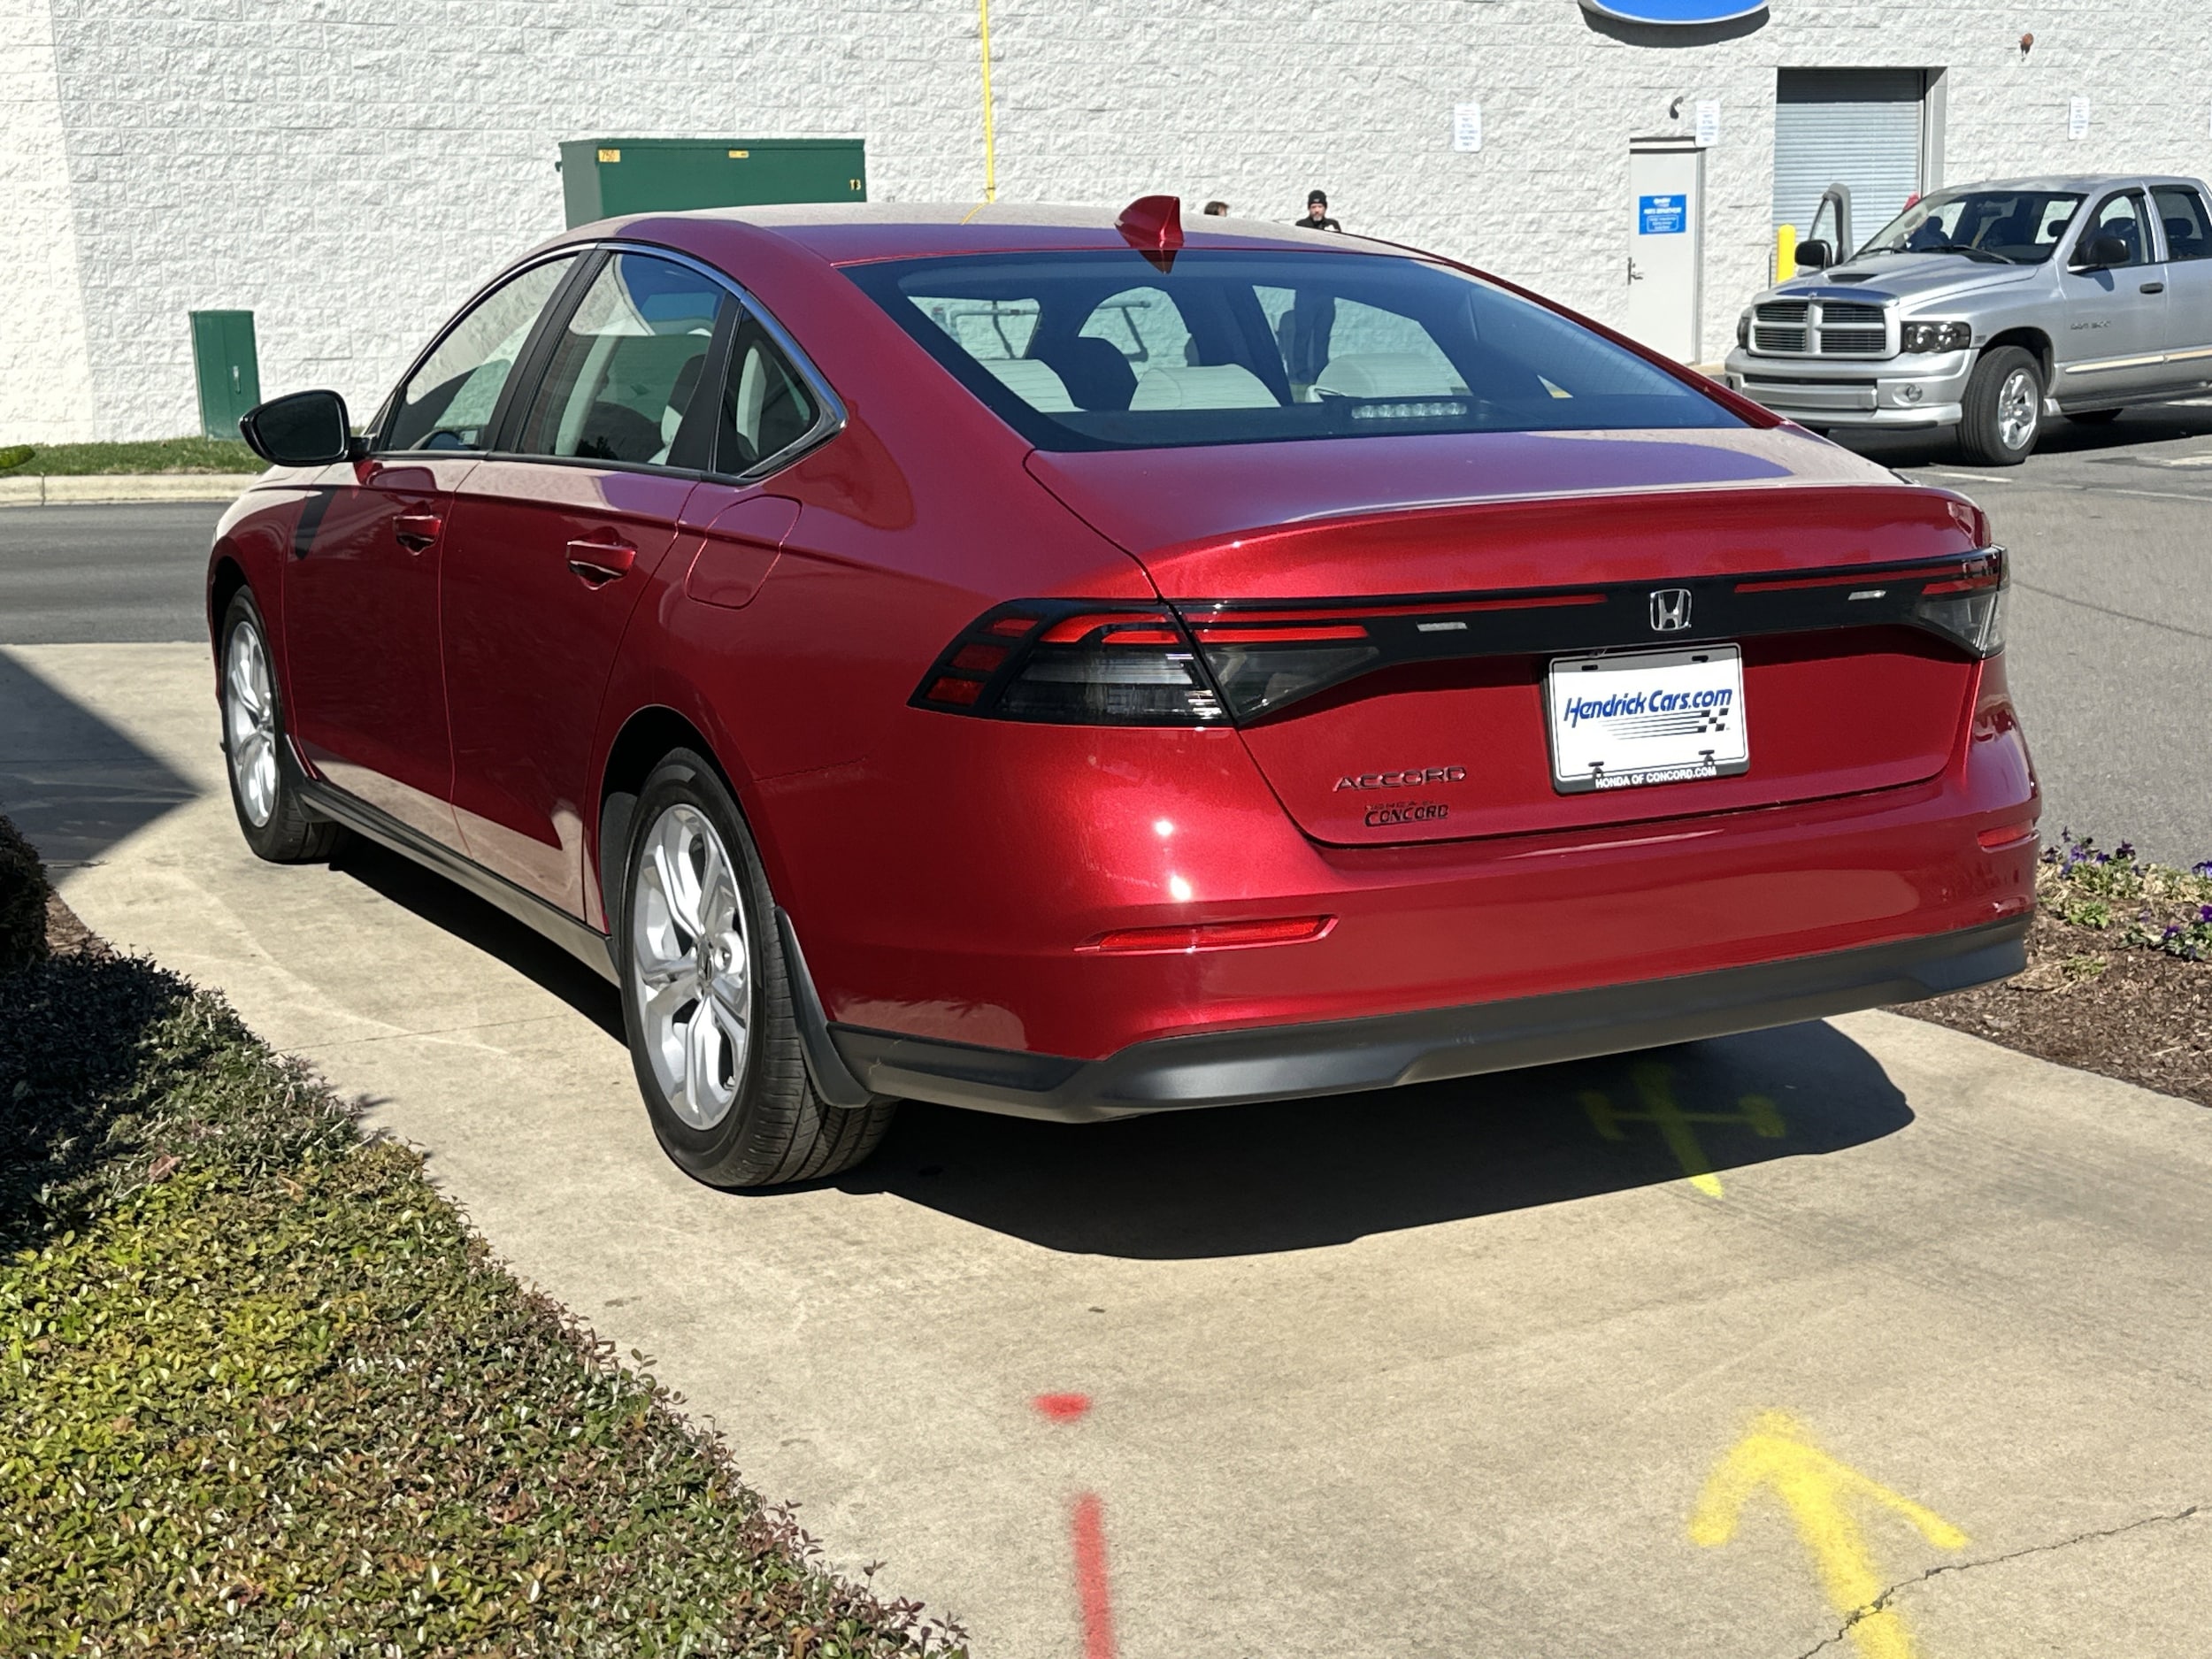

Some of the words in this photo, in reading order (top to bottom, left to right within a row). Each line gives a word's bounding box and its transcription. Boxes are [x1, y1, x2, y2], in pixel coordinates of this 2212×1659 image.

[1333, 766, 1467, 793] ACCORD
[1595, 776, 1630, 788] HONDA
[1632, 774, 1645, 784] OF
[1647, 766, 1717, 783] CONCORD.COM
[1364, 804, 1449, 827] CONCORD
